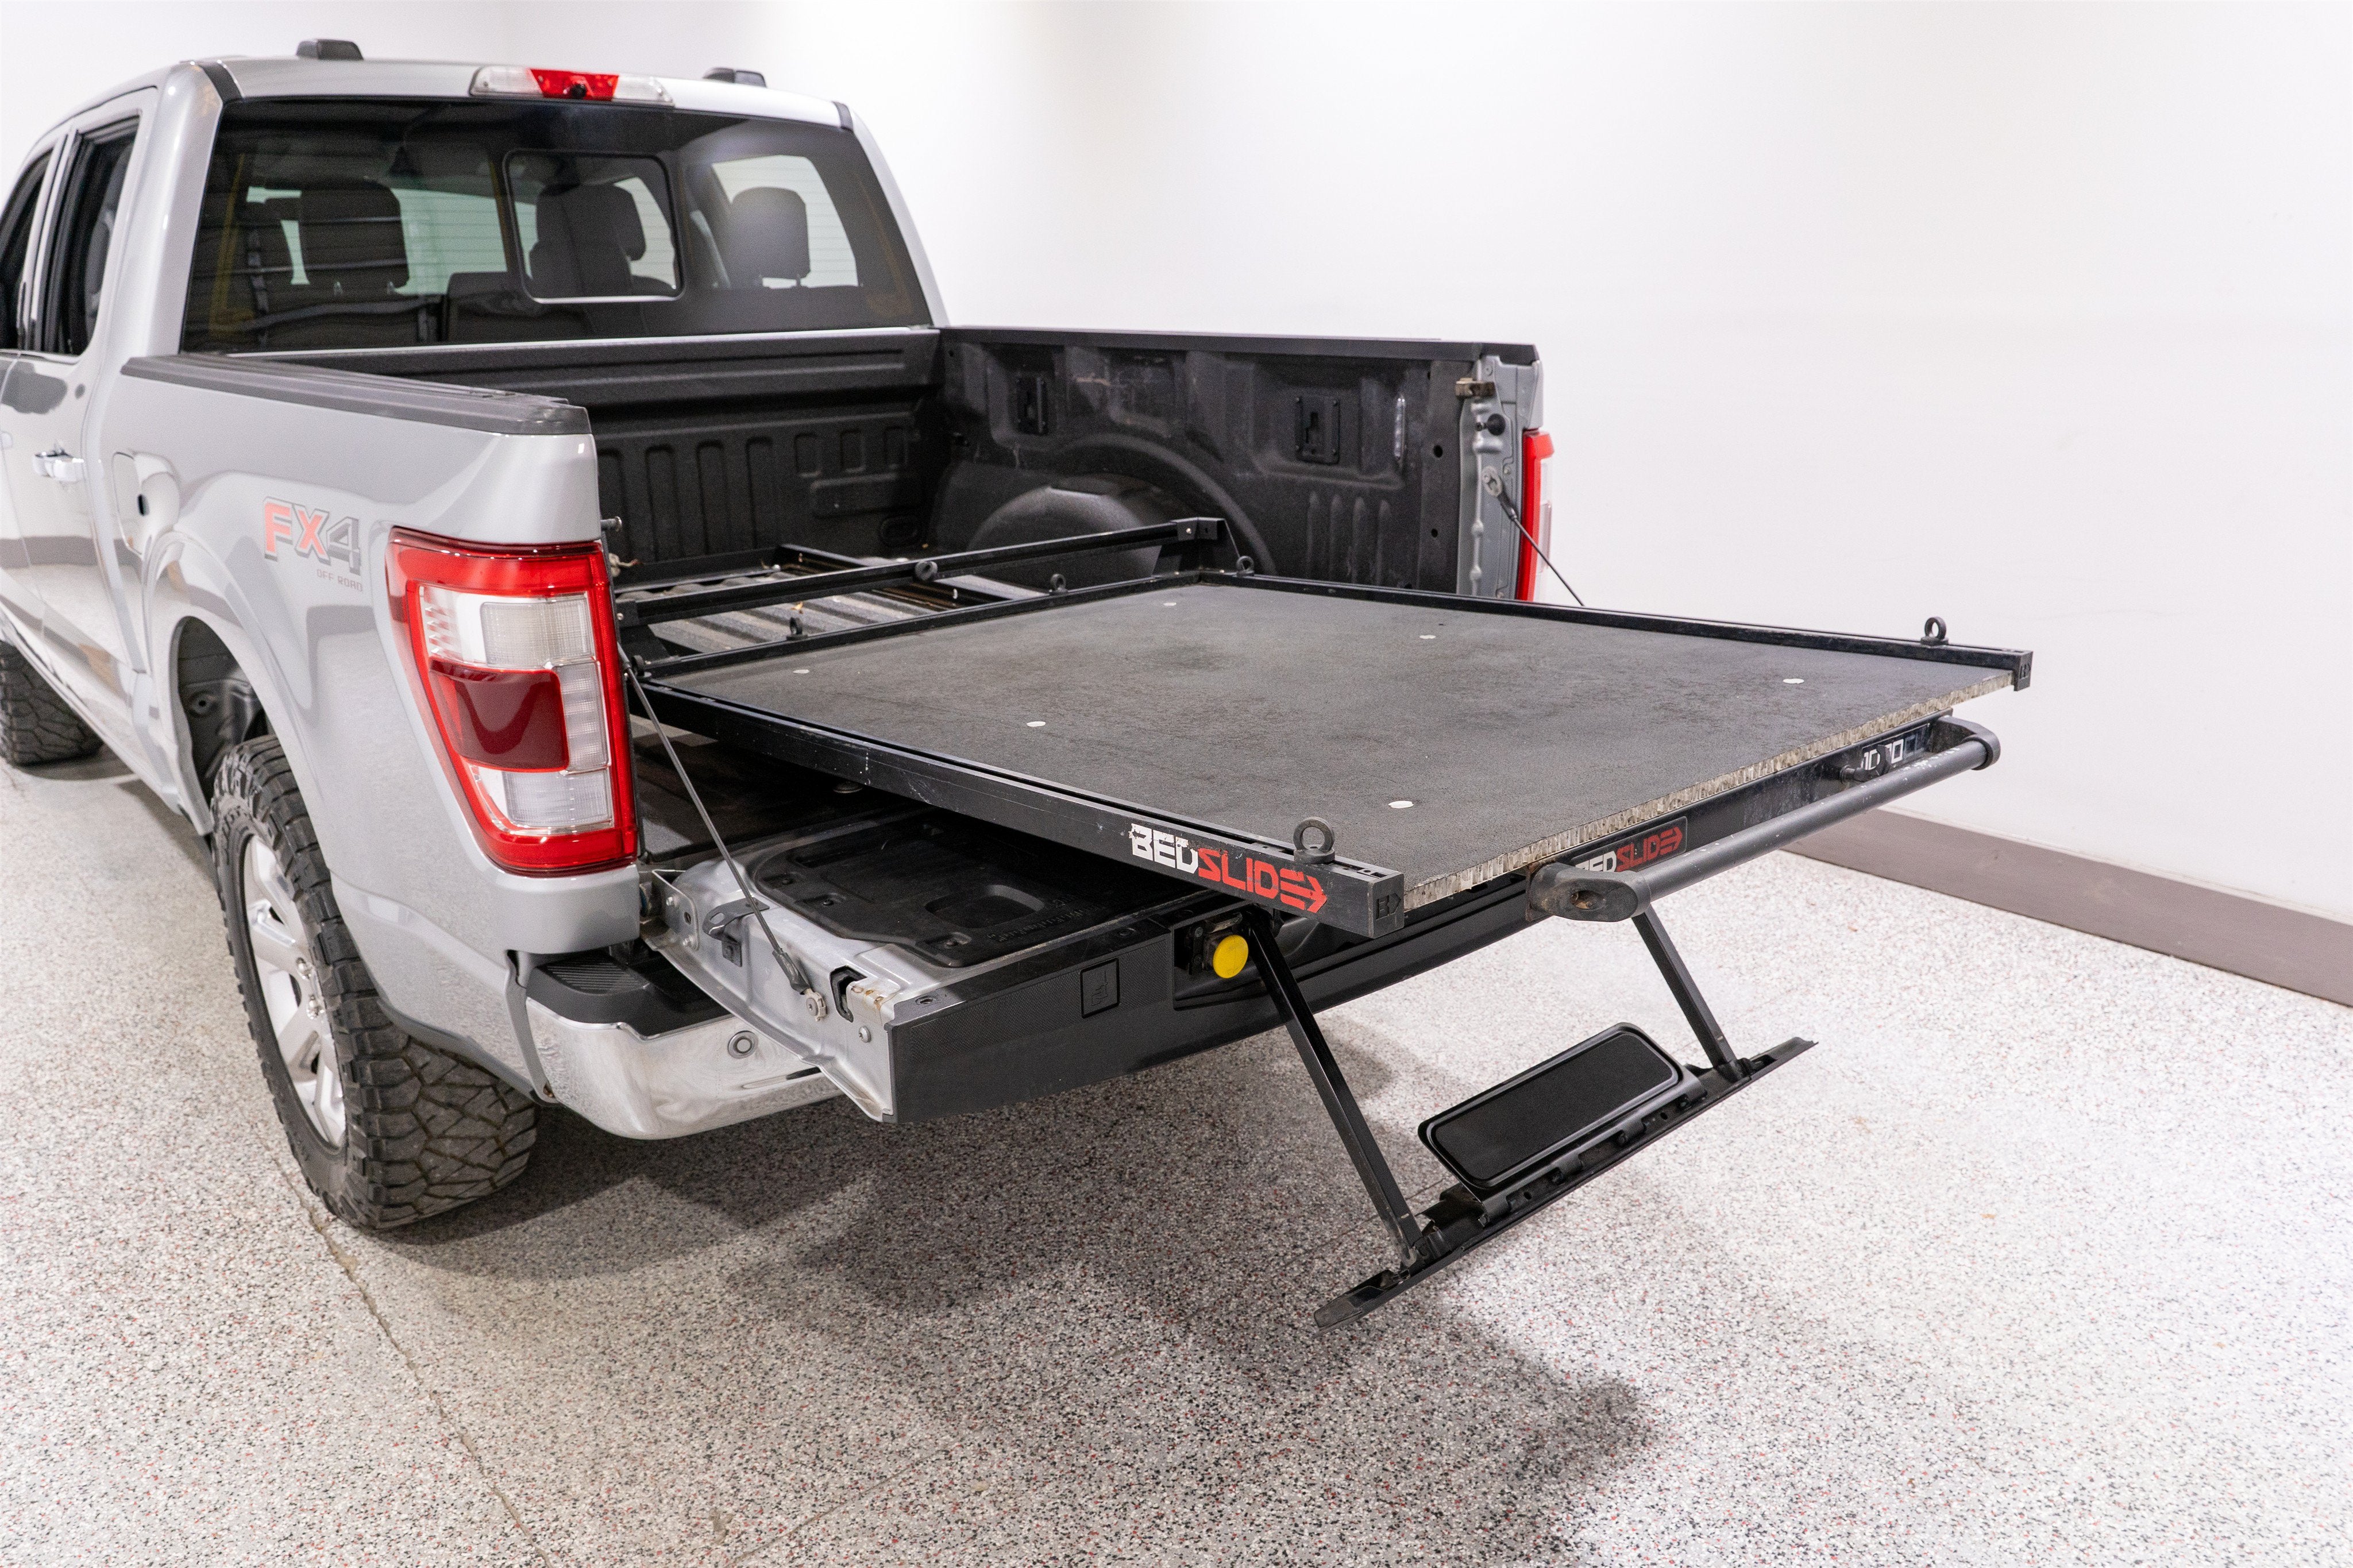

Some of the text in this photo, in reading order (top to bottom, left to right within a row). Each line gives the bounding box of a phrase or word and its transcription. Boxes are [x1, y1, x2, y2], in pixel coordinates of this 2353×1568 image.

[263, 496, 361, 576] FX4
[317, 569, 364, 592] OFF ROAD
[1129, 822, 1328, 913] BEDSLIDE
